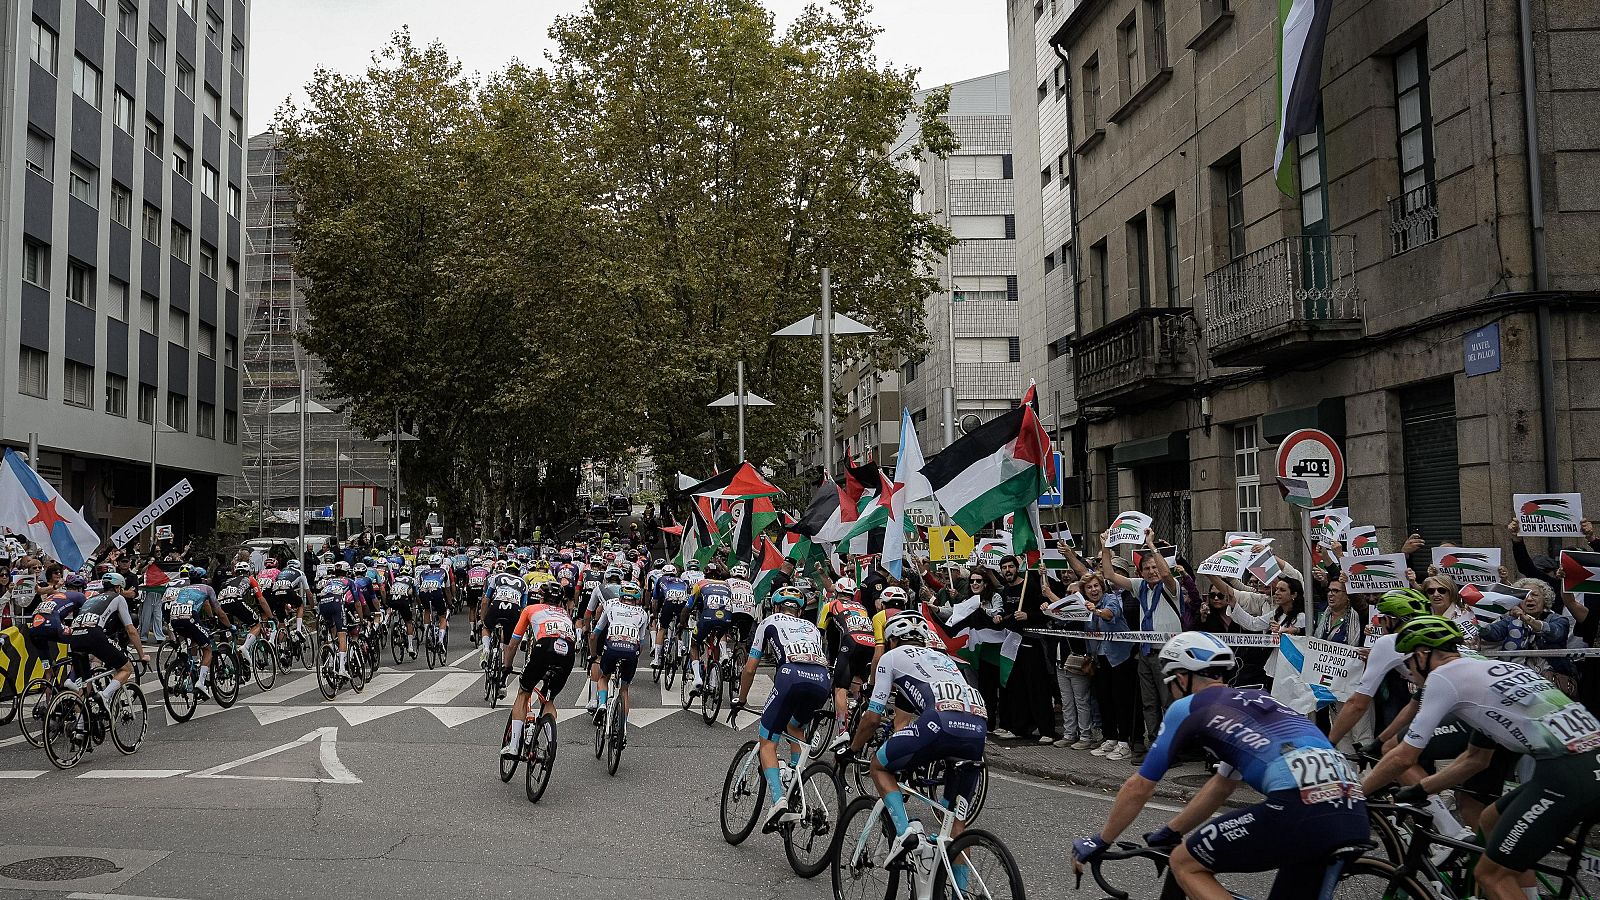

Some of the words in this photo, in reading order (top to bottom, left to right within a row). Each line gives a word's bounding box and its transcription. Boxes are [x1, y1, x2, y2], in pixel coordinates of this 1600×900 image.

[1471, 340, 1490, 351] MANUEL
[1467, 353, 1476, 362] DEL
[1477, 349, 1496, 360] PALACIO
[1306, 461, 1318, 472] 10
[1321, 461, 1328, 472] t
[1520, 515, 1546, 524] GALIZA
[1522, 524, 1537, 533] CON
[1539, 524, 1578, 533] PALESTINA
[1116, 533, 1140, 541] PALESTINA
[1353, 547, 1375, 557] GALIZA
[1212, 565, 1239, 574] PALESTINA
[1366, 581, 1404, 589] PALESTINA
[1457, 575, 1496, 583] PALESTINA
[610, 626, 625, 636] 107
[787, 643, 809, 655] 103
[1319, 654, 1327, 662] CO
[1328, 656, 1346, 666] POBO
[1313, 663, 1348, 678] PALESTINO
[936, 683, 963, 702] 102
[948, 720, 976, 728] BAHRAIN
[1486, 710, 1513, 729] CAJA
[1549, 709, 1597, 742] 146
[1206, 715, 1271, 749] FACTOR
[1434, 724, 1458, 736] RGA
[1291, 753, 1340, 787] 225
[958, 800, 966, 818] 102
[1522, 798, 1555, 824] RGA
[1218, 812, 1256, 832] PREMIER
[1222, 826, 1250, 842] TECH
[1499, 820, 1529, 855] SEGUROS
